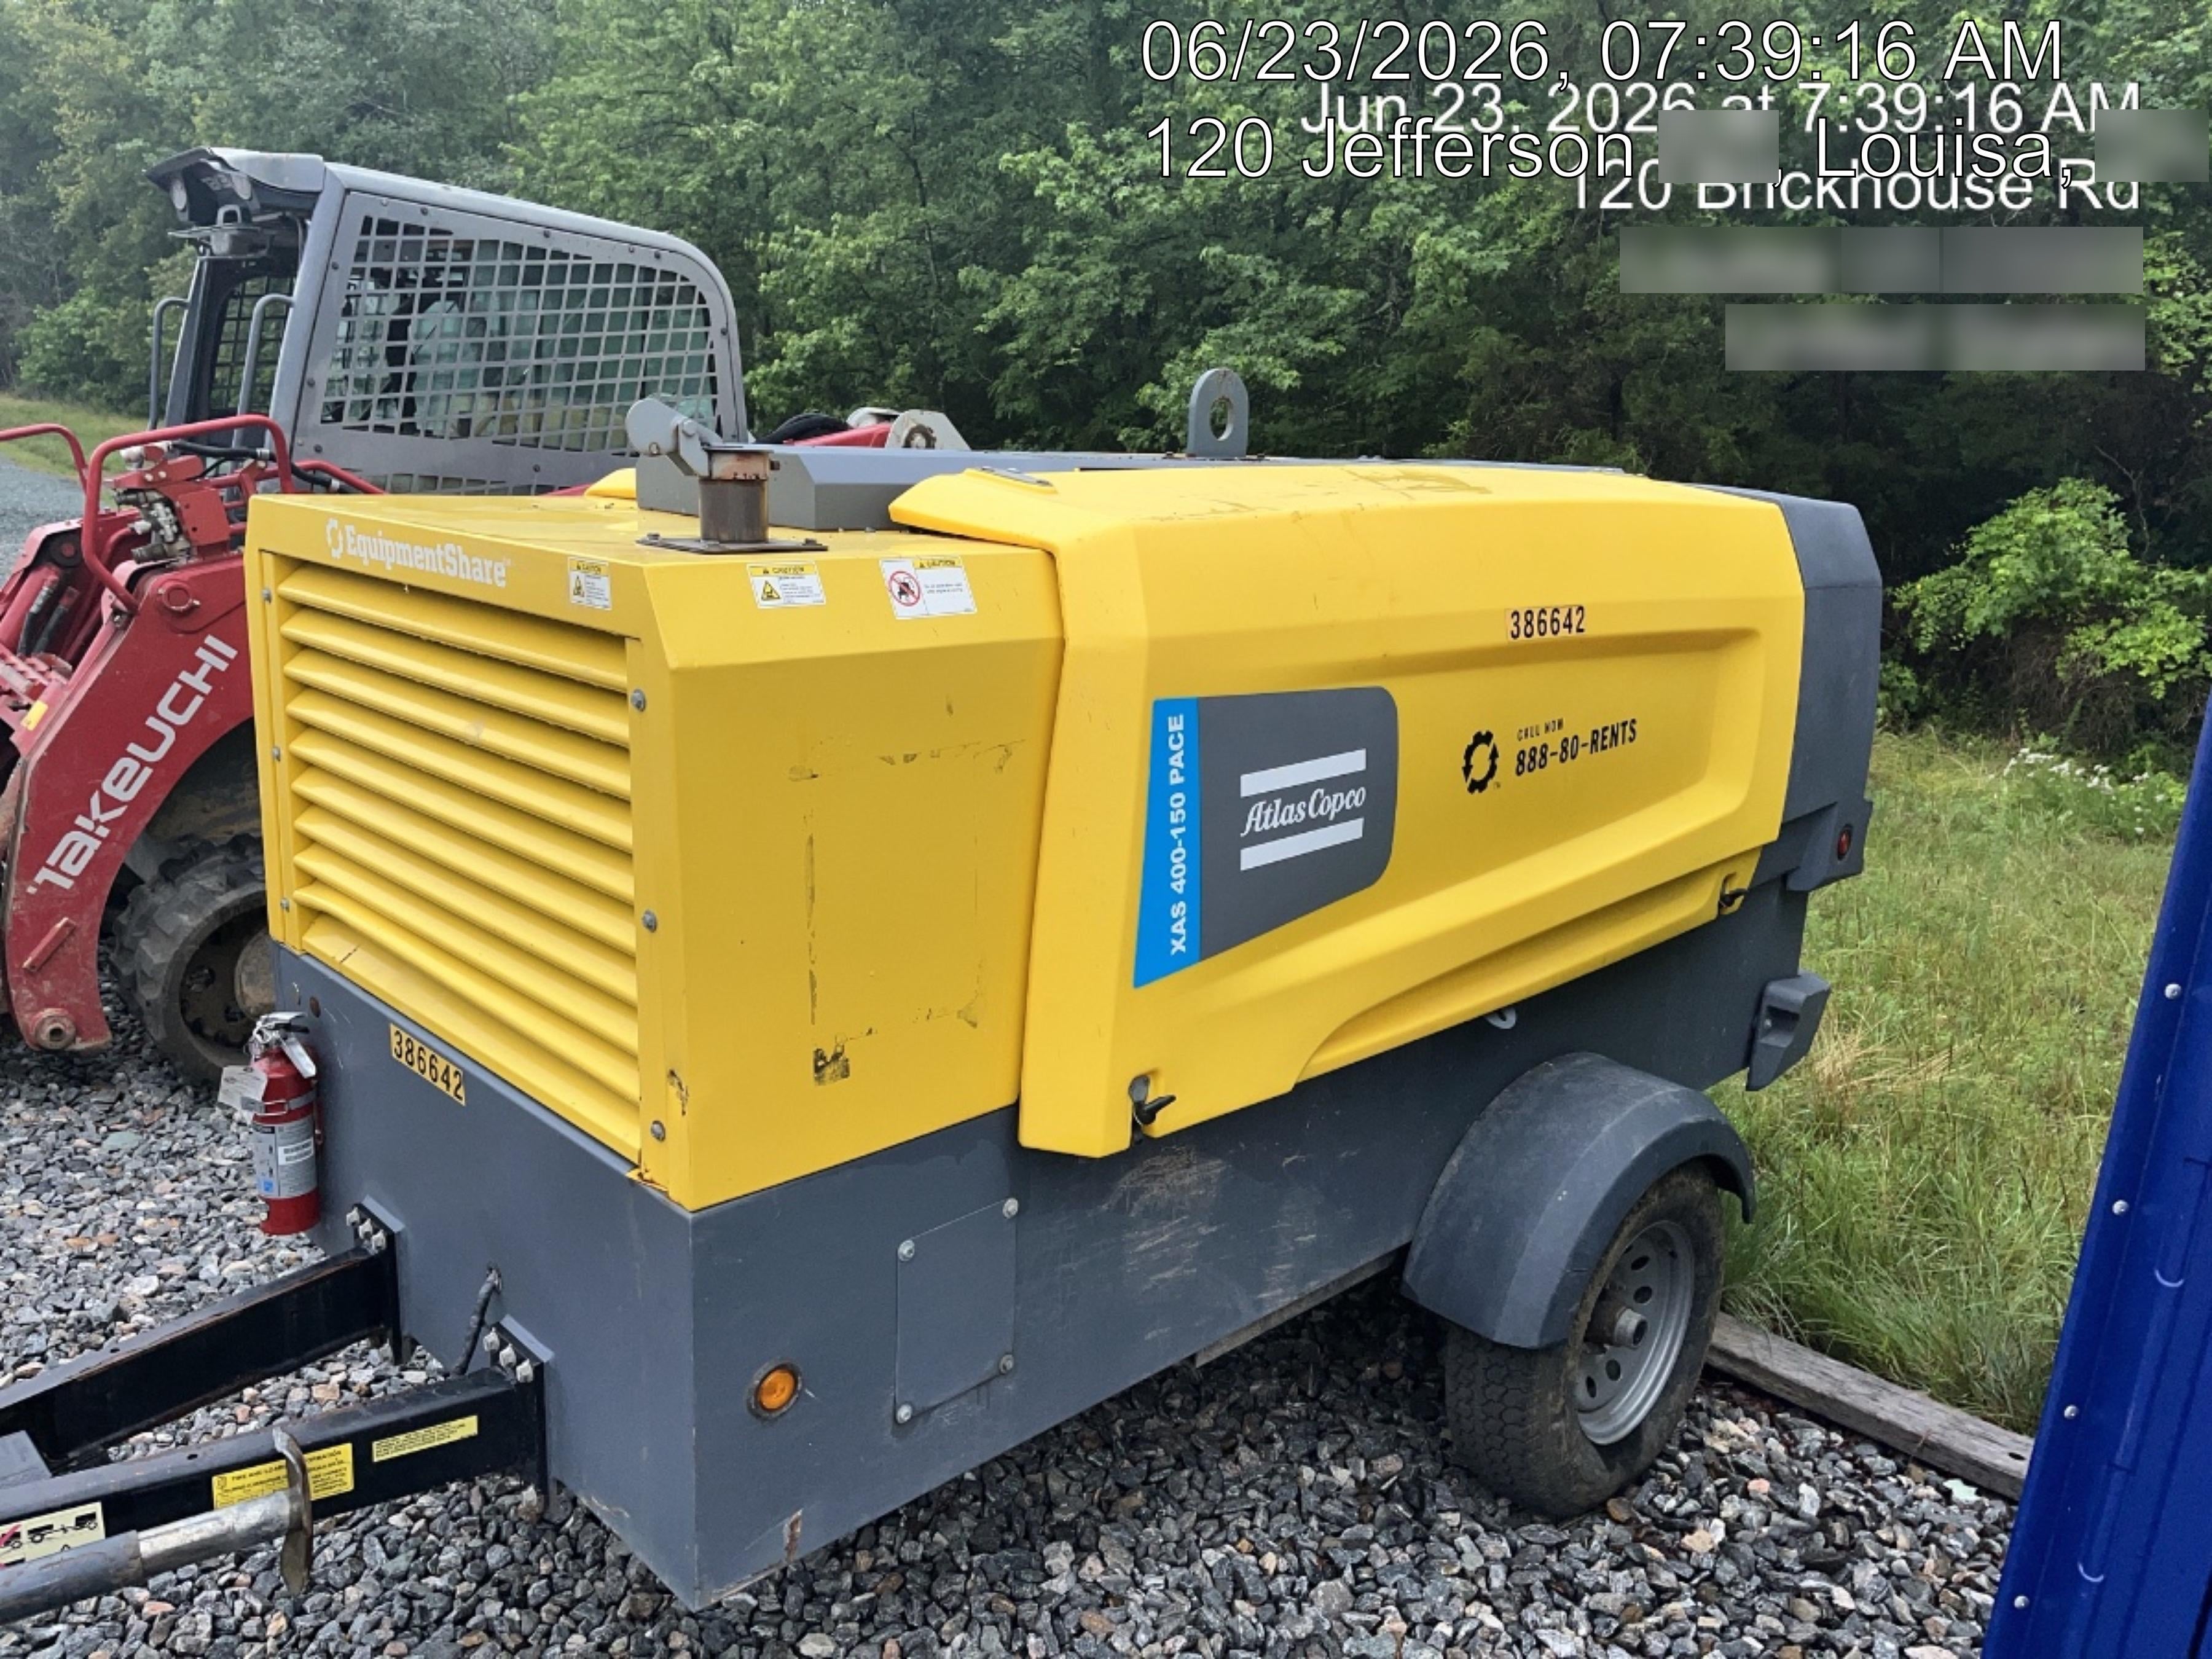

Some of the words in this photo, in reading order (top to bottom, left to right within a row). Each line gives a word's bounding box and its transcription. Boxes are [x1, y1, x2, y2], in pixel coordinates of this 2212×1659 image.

[345, 524, 506, 588] EquipmentShare
[1511, 606, 1586, 640] 386642
[1168, 714, 1185, 784] PACE
[1515, 718, 1637, 776] 888-80-RENTS
[1517, 725, 1540, 741] CALL
[1544, 718, 1564, 734] NOW
[1171, 794, 1186, 894] 400-150
[1171, 901, 1186, 954] XAS
[394, 1030, 463, 1100] 386642
